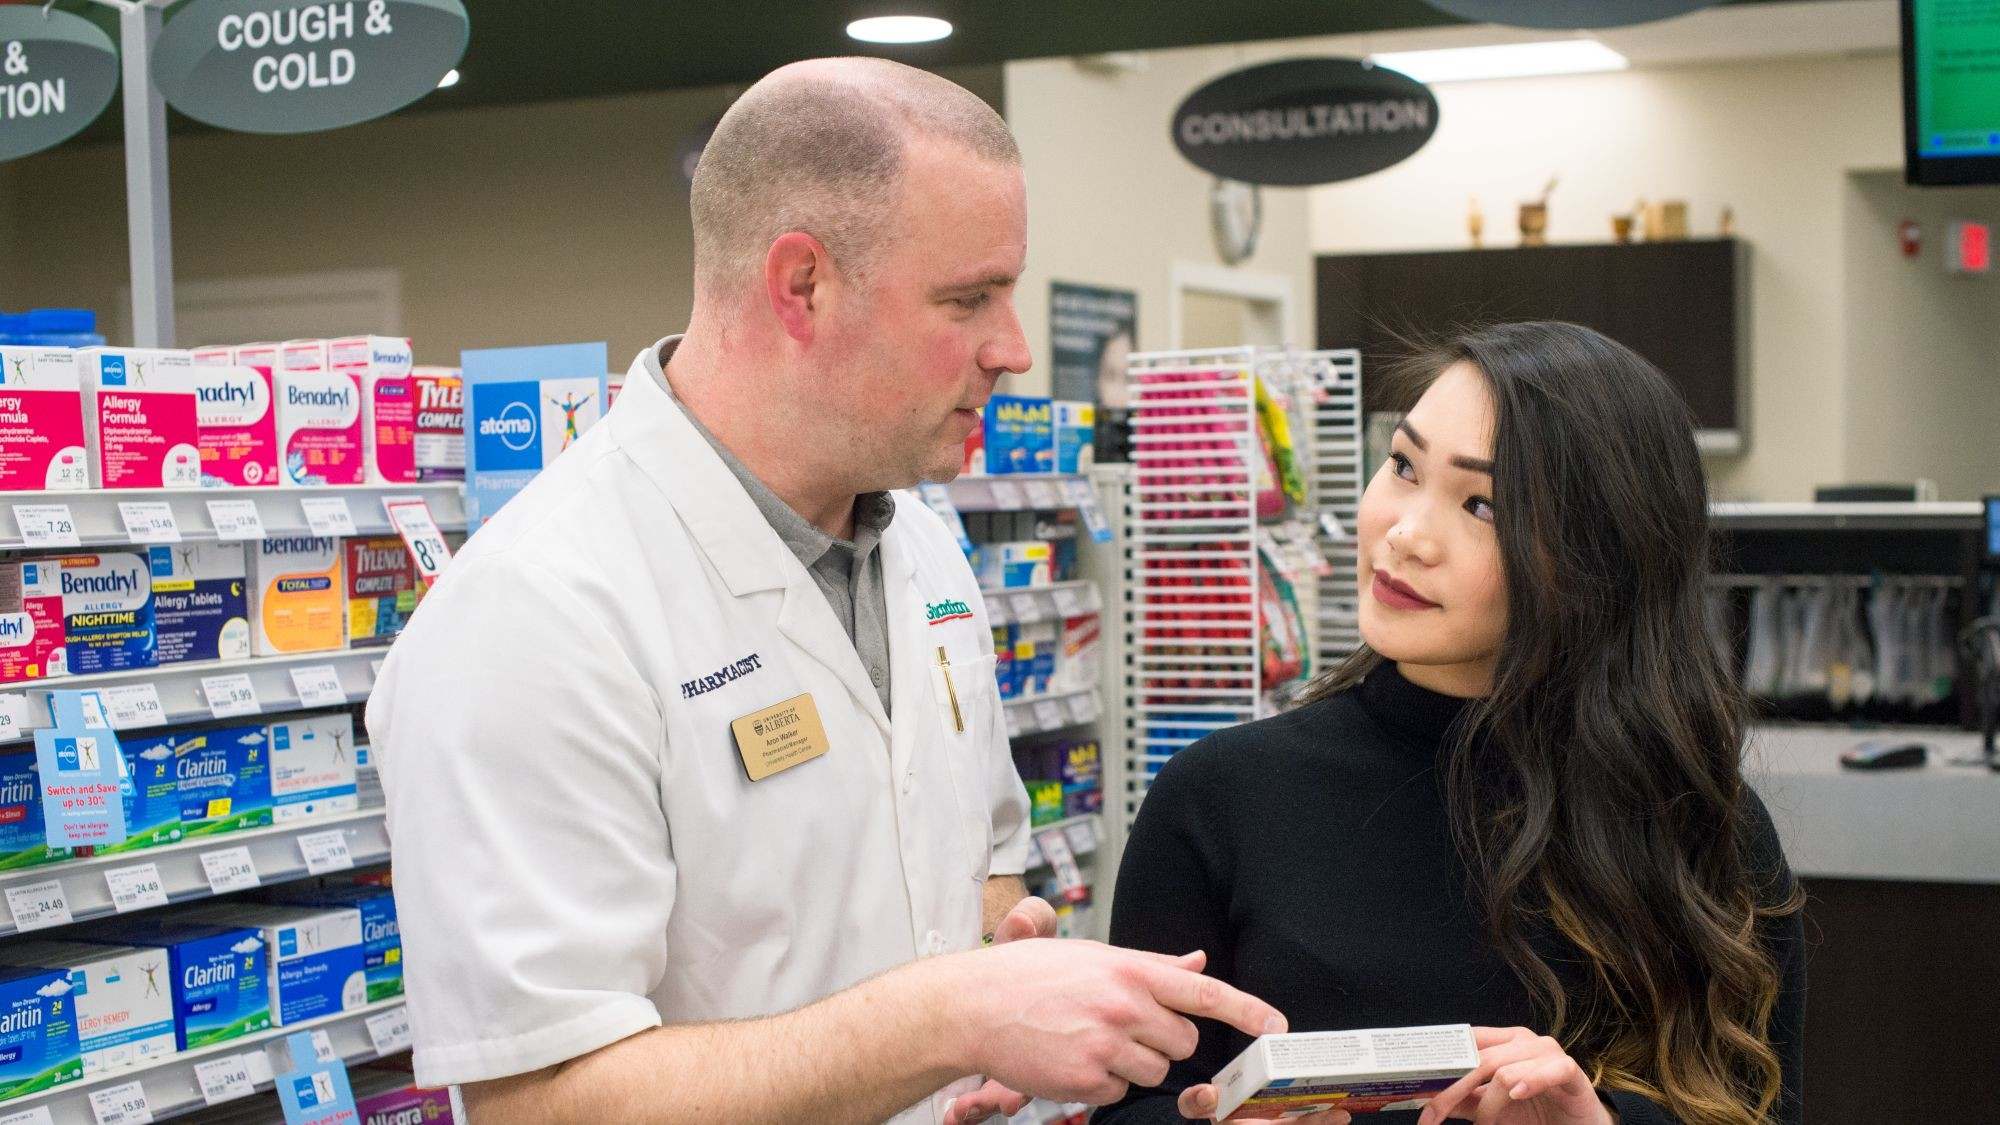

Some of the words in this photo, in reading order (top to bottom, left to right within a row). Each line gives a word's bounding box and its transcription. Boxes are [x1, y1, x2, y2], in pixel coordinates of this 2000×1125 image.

[218, 3, 354, 51] COUGH
[364, 0, 392, 35] &
[5, 42, 29, 76] &
[253, 49, 356, 93] COLD
[1182, 100, 1429, 144] CONSULTATION
[373, 350, 409, 363] Benadryl
[103, 396, 141, 412] Allergy
[288, 385, 349, 409] Benadryl
[0, 410, 28, 423] mula
[103, 410, 147, 424] Formula
[480, 417, 531, 435] atoma
[46, 520, 72, 533] 7.29
[354, 542, 407, 574] TYLENOL
[61, 568, 137, 597] Benadryl
[281, 579, 310, 592] TOTAL
[355, 575, 393, 593] COMPLETE
[84, 602, 123, 611] ALLERGY
[154, 595, 188, 609] Allergy
[190, 593, 223, 606] Tablets
[72, 612, 135, 627] NIGHTTIME
[230, 689, 252, 702] 9.99
[764, 713, 801, 734] ALBERTA
[176, 754, 227, 779] Claritin
[0, 780, 33, 804] ritin
[47, 784, 76, 796] Switch
[79, 784, 94, 795] and
[96, 783, 118, 793] Save
[62, 800, 73, 811] up
[87, 796, 105, 806] 30%
[136, 881, 159, 894] 24.49
[38, 899, 63, 912] 24.49
[184, 961, 235, 989] Claritin
[280, 967, 304, 981] Allergy
[0, 1006, 42, 1034] aritin
[103, 1011, 130, 1025] REMEDY
[122, 1098, 146, 1112] 15.99
[366, 1106, 422, 1125] Allegra
